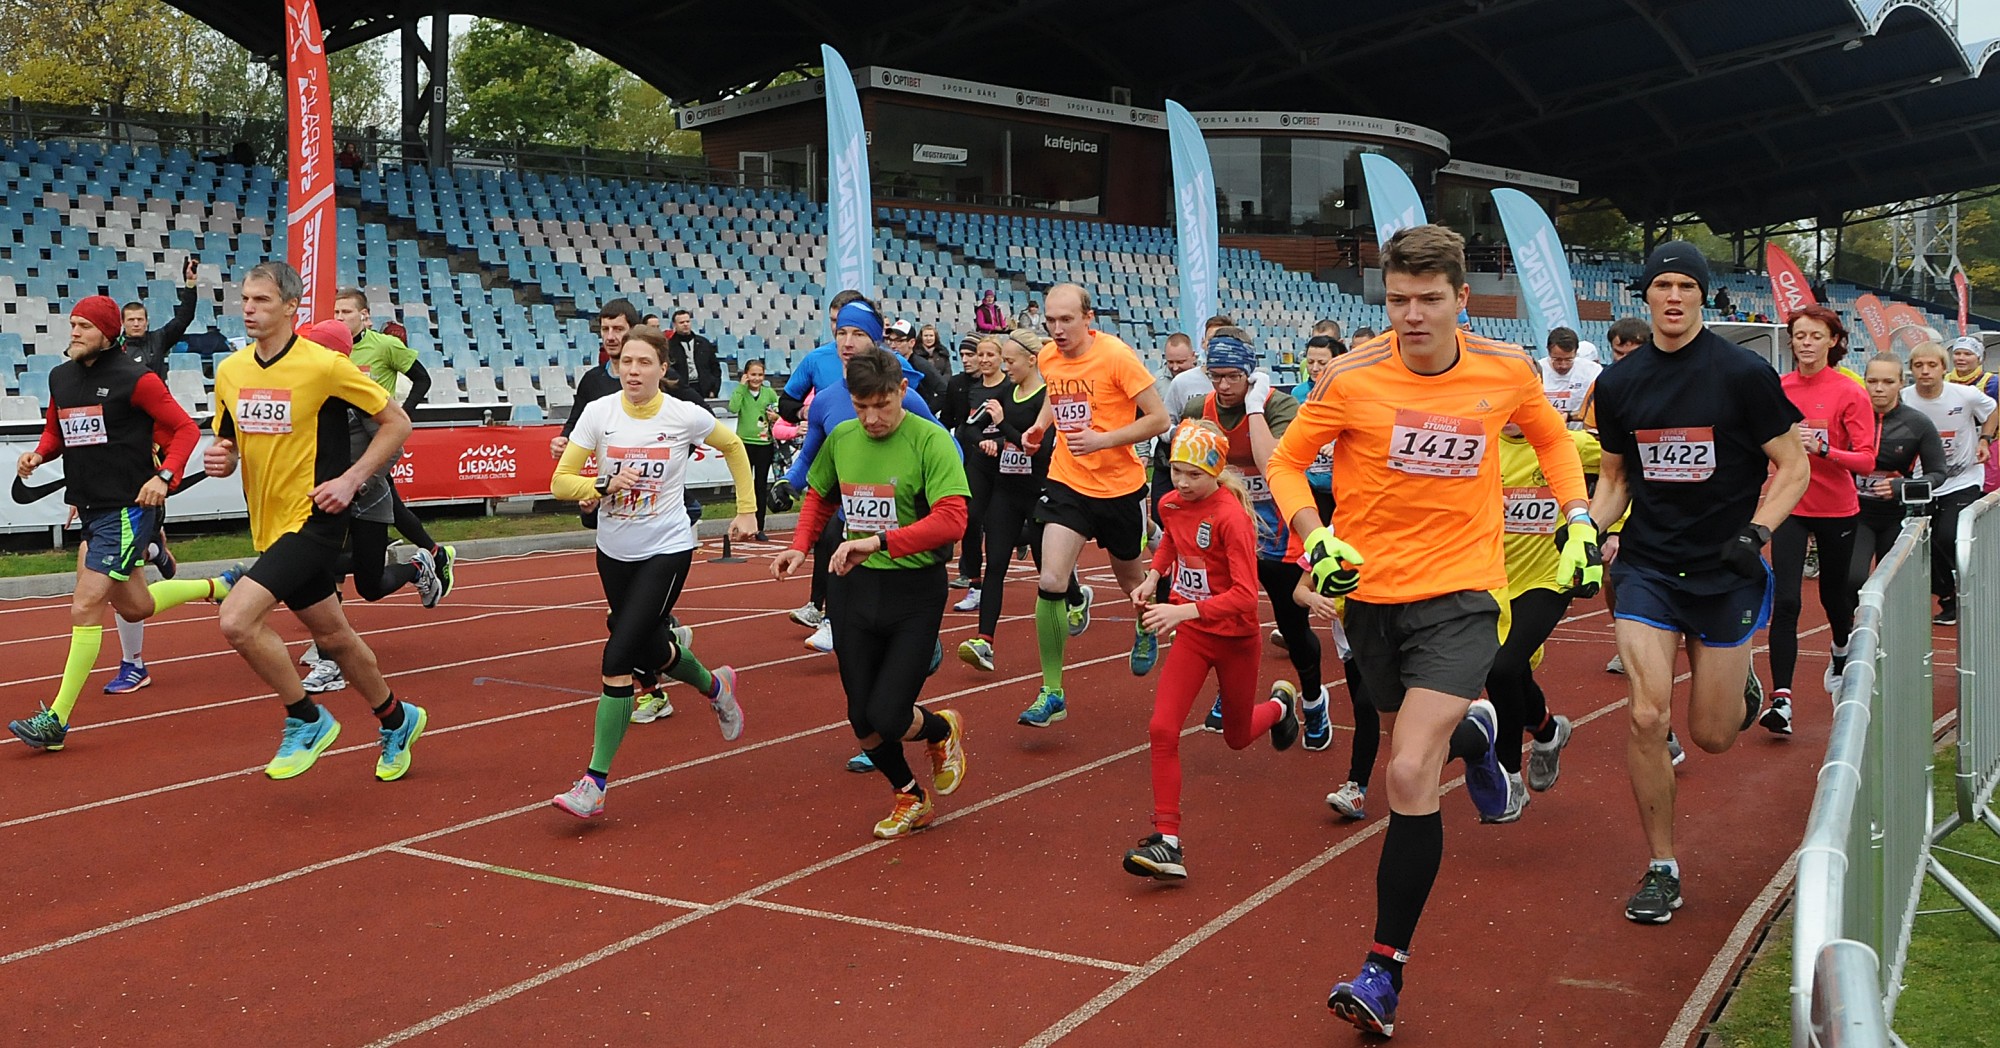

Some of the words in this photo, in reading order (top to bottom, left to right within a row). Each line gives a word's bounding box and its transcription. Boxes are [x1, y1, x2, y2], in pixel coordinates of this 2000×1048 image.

[893, 74, 921, 88] OPTIBET
[942, 84, 972, 94] SPORTA
[1026, 95, 1050, 107] OPTIBET
[1067, 102, 1093, 112] SPORTA
[696, 105, 725, 120] OPTIBET
[1138, 112, 1159, 124] OPTIBET
[1292, 116, 1320, 126] OPTIBET
[1044, 134, 1098, 154] kafejnica
[241, 402, 286, 420] 1438
[1055, 404, 1086, 420] 1459
[65, 418, 100, 434] 1449
[1422, 421, 1457, 432] STUNDA
[1398, 432, 1479, 460] 1413
[1648, 445, 1708, 465] 1422
[458, 458, 516, 474] LIEPĀJAS
[613, 461, 664, 478] 119
[847, 499, 890, 518] 1420
[1504, 502, 1556, 520] 402
